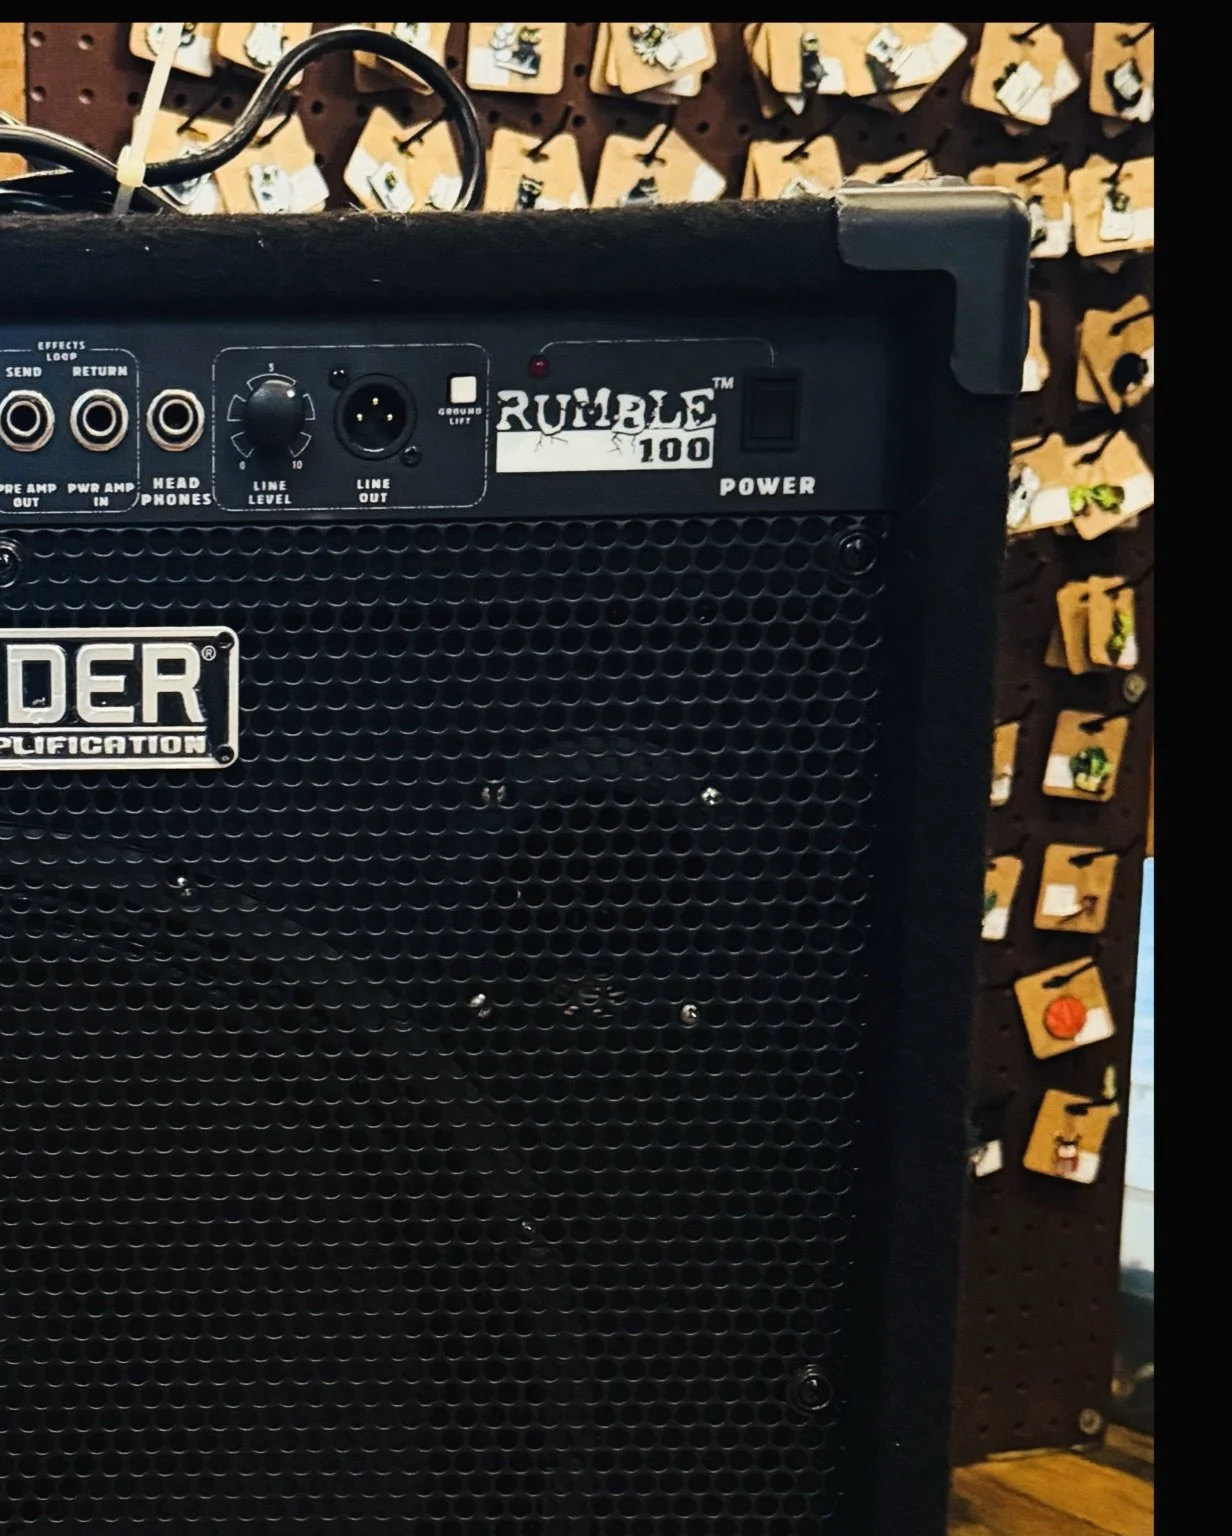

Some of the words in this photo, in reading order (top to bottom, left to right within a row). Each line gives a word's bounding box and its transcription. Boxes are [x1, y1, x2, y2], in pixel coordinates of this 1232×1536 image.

[37, 341, 86, 350] EFFECTS
[46, 352, 77, 361] LOOP
[6, 366, 42, 377] SEND
[72, 366, 128, 377] RETURN
[269, 363, 274, 372] 5
[438, 407, 482, 415] GROUND
[496, 387, 717, 436] RUMBLE
[449, 417, 472, 425] LIFT
[639, 437, 711, 463] 100
[239, 461, 245, 470] 0
[292, 460, 303, 469] 10
[26, 483, 57, 494] AMP
[68, 483, 100, 493] PWR
[103, 482, 135, 493] AMP
[153, 477, 200, 489] HEAD
[253, 481, 287, 491] LINE
[357, 479, 390, 490] LINE
[719, 476, 816, 496] POWER
[13, 497, 39, 508] OUT
[93, 497, 109, 507] IN
[141, 494, 212, 506] PHONES
[248, 494, 292, 505] LEVEL
[359, 493, 388, 503] OUT
